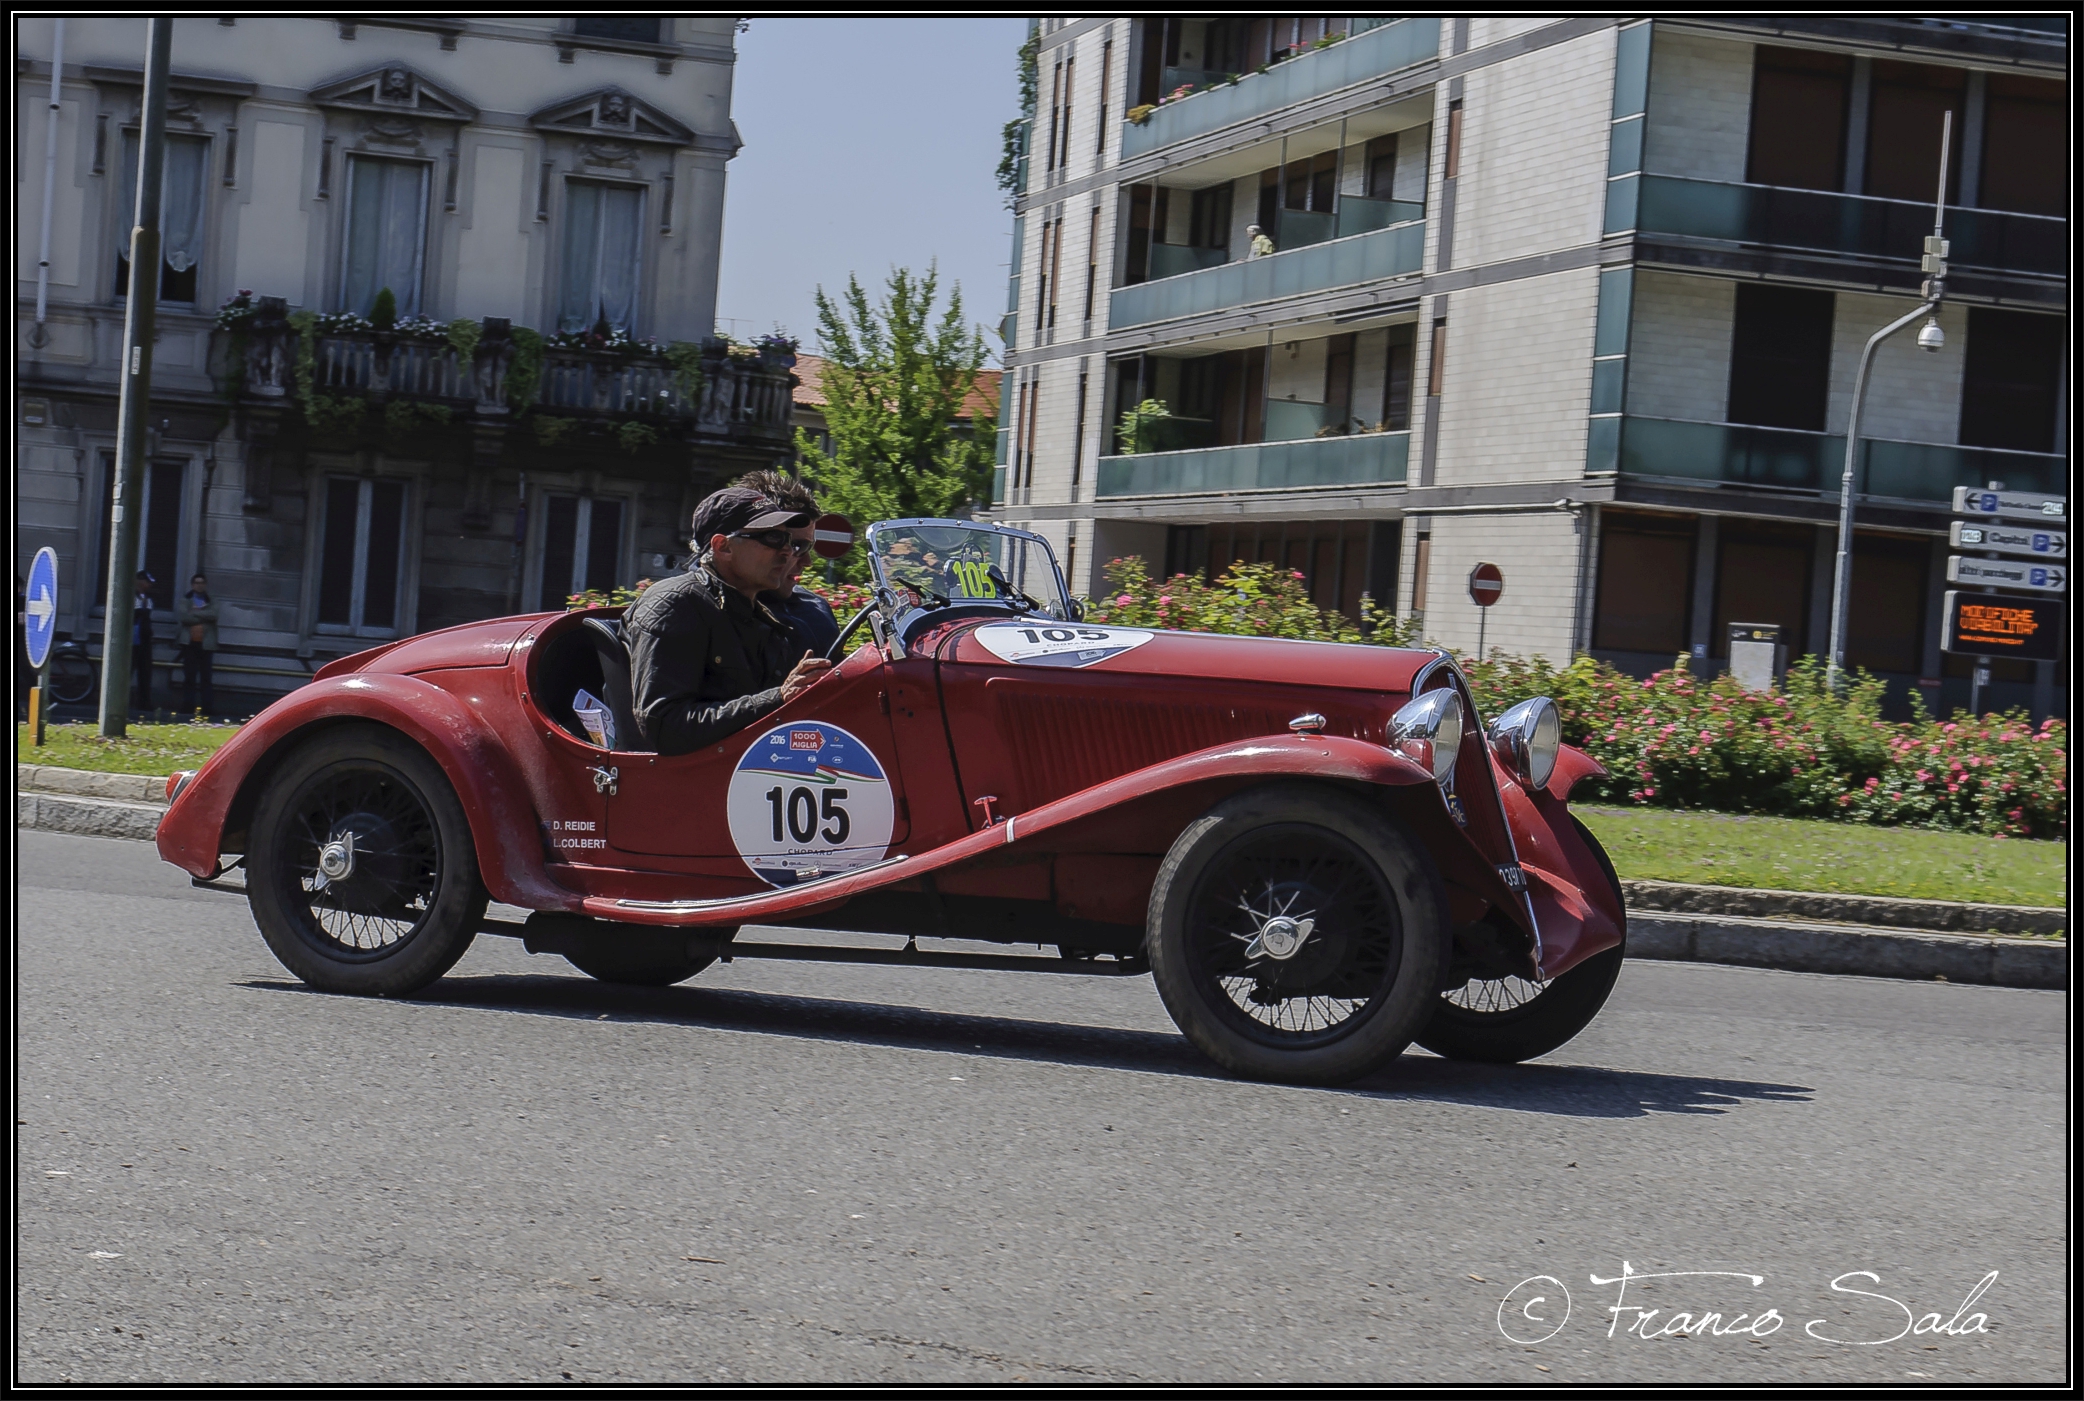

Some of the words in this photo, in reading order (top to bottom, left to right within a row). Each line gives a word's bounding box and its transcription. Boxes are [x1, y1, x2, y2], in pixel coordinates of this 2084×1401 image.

[952, 561, 997, 599] 105
[1017, 628, 1110, 644] 105
[769, 734, 786, 745] 2016
[792, 741, 818, 749] MIGLIA
[765, 785, 850, 845] 105
[553, 820, 563, 831] D.
[564, 820, 596, 831] REIDIE
[787, 848, 833, 856] CHOPARD
